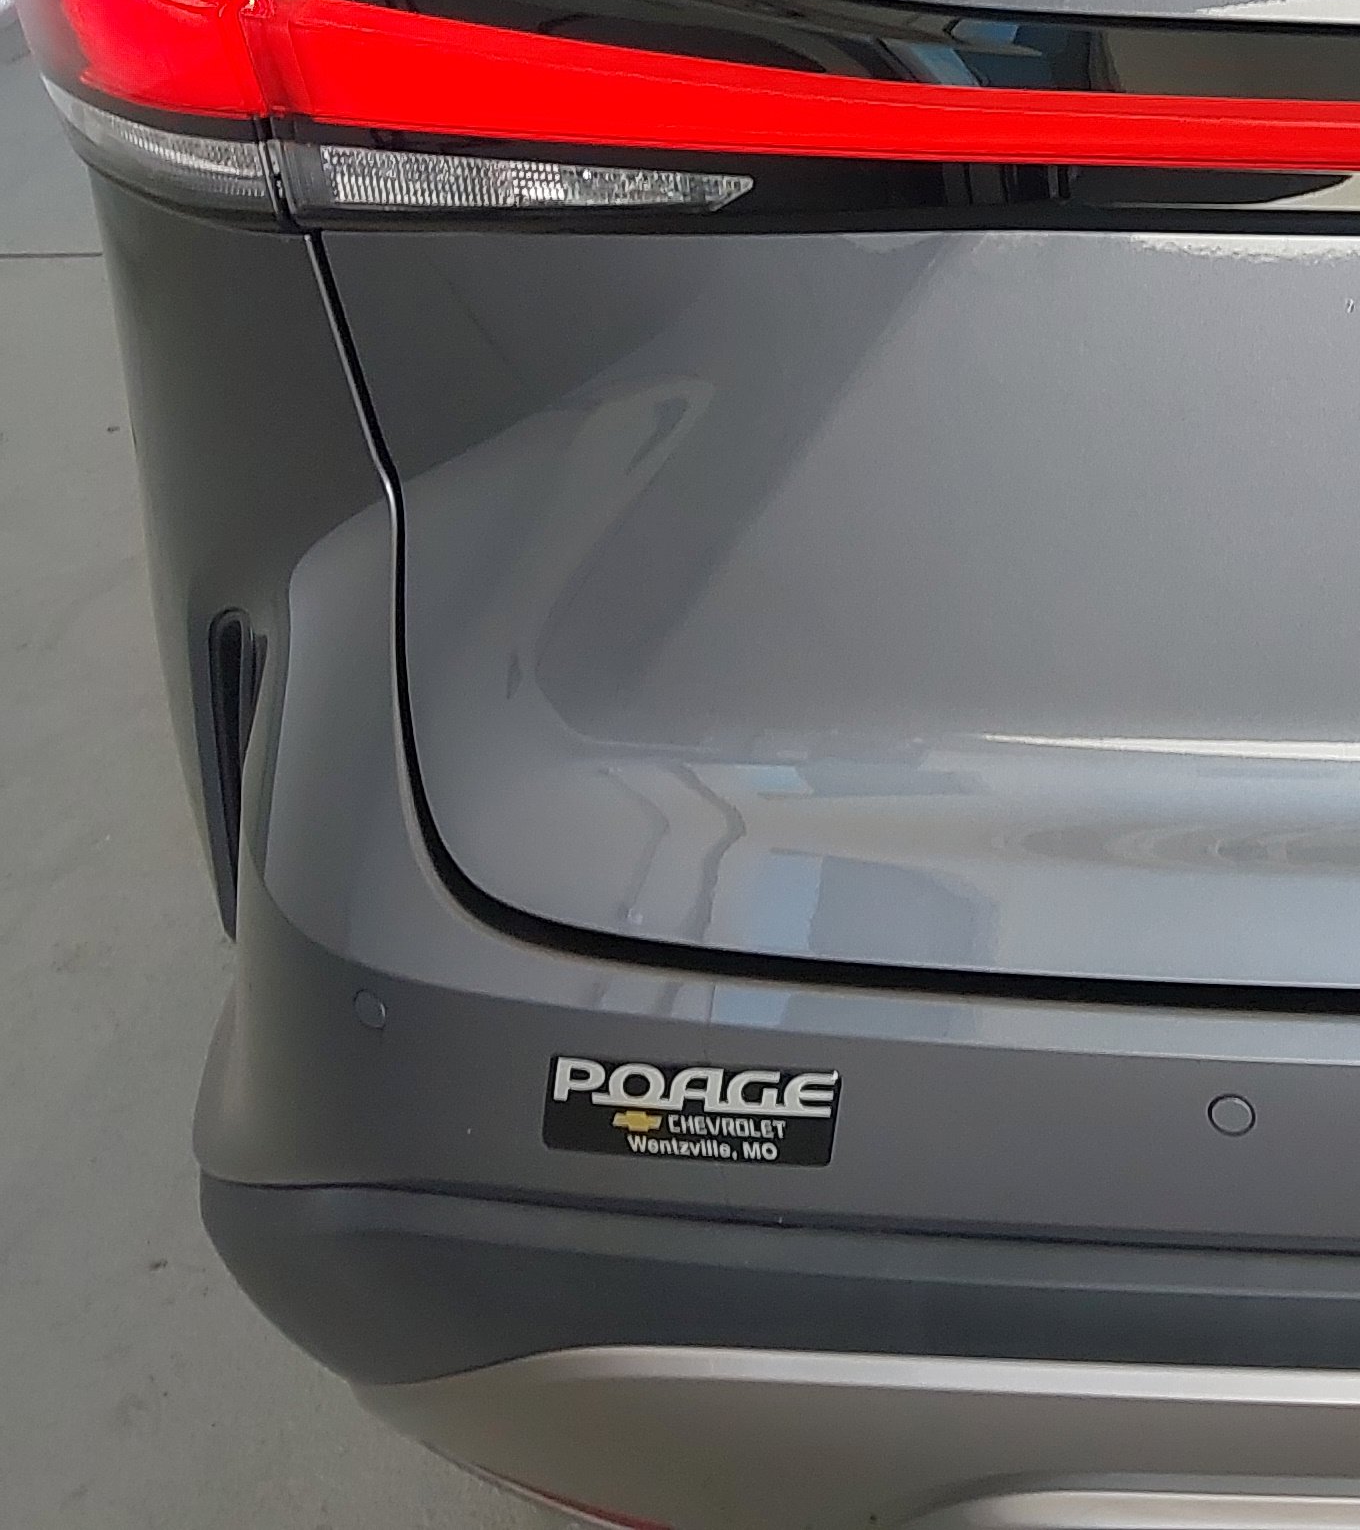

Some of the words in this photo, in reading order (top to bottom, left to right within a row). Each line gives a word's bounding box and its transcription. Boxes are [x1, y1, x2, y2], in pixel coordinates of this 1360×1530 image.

[553, 1056, 839, 1118] POAGE
[667, 1113, 786, 1139] CHEVROLET
[627, 1134, 738, 1161] Wentzville,
[743, 1141, 778, 1161] MO
